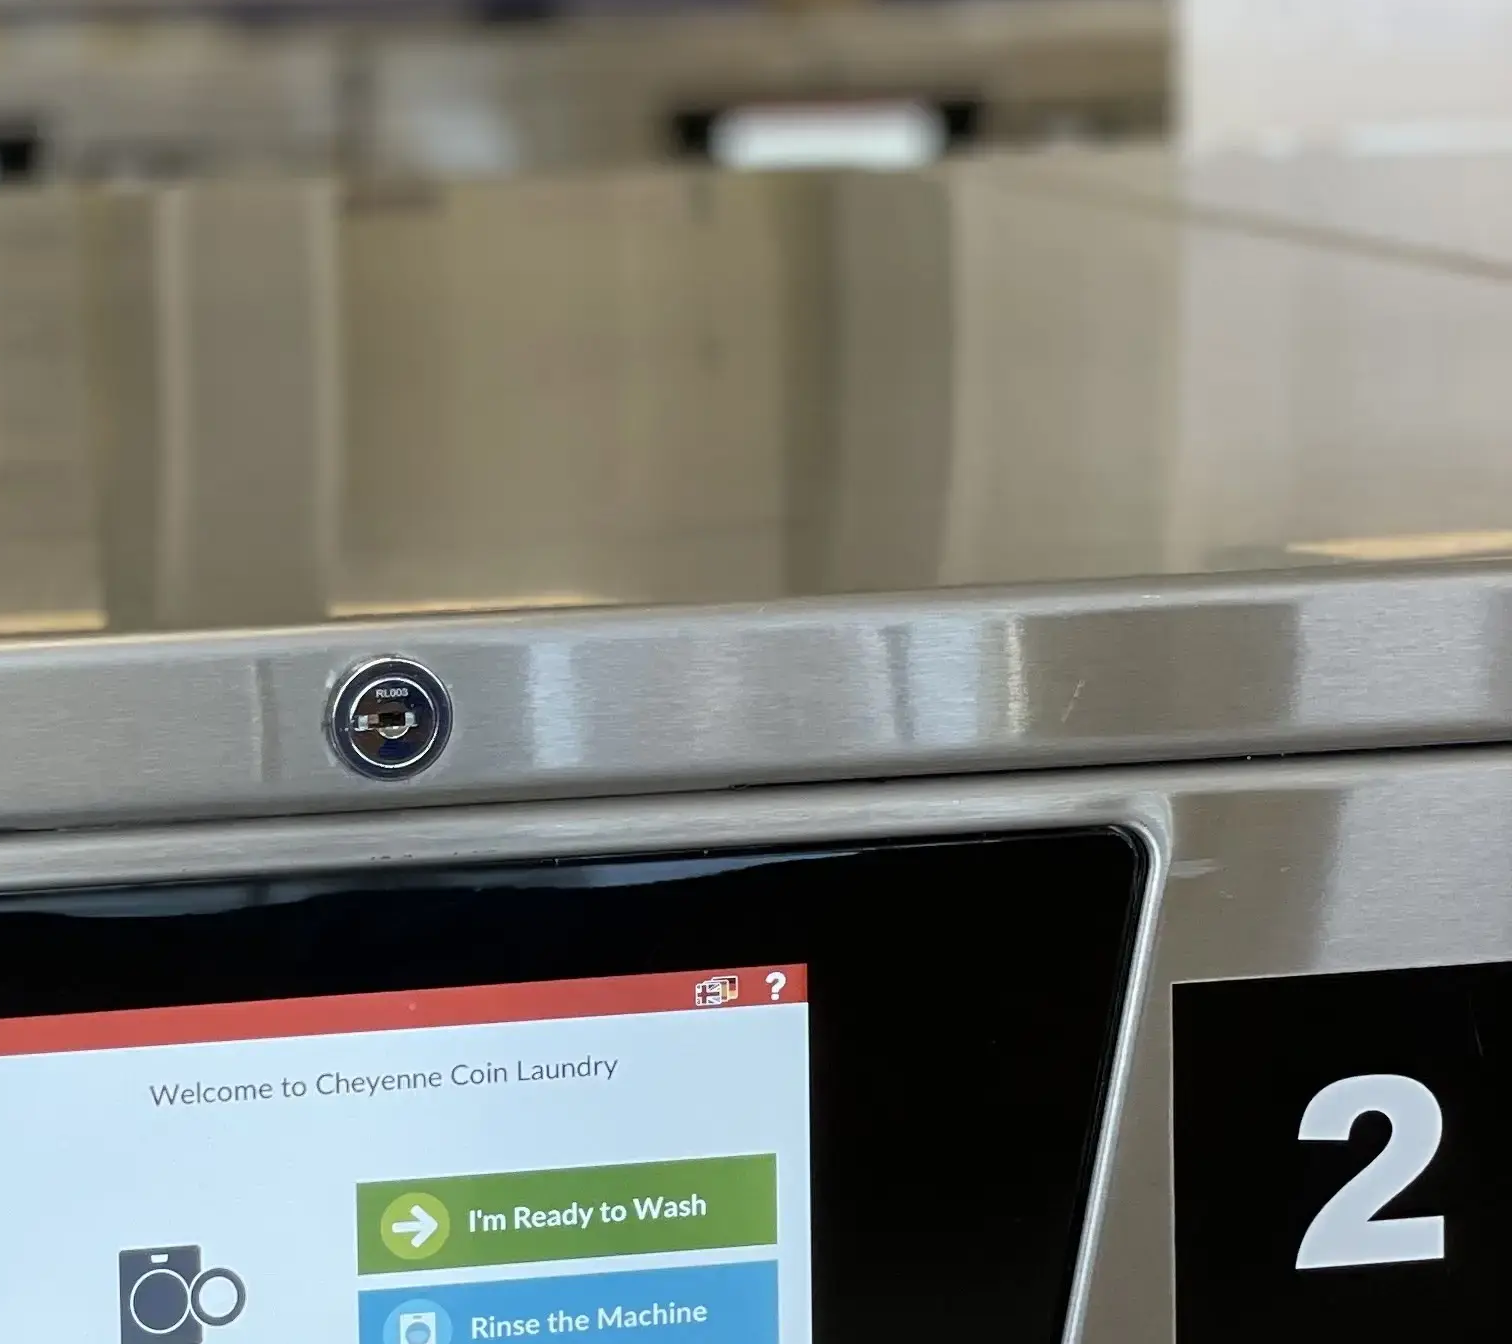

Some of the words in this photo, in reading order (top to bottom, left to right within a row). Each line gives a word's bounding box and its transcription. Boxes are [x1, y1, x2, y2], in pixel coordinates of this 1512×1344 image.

[149, 1080, 274, 1108] Welcome
[281, 1078, 308, 1099] to
[316, 1069, 443, 1097] Cheyenne
[450, 1062, 508, 1087] Coin
[517, 1056, 619, 1081] Laundry
[1295, 1073, 1446, 1271] 2
[468, 1208, 507, 1233] I'm
[513, 1201, 594, 1230] Ready
[599, 1201, 627, 1223] to
[632, 1193, 708, 1222] Wash
[470, 1315, 540, 1340] Rinse
[546, 1309, 590, 1334] the
[596, 1301, 709, 1331] Machine
